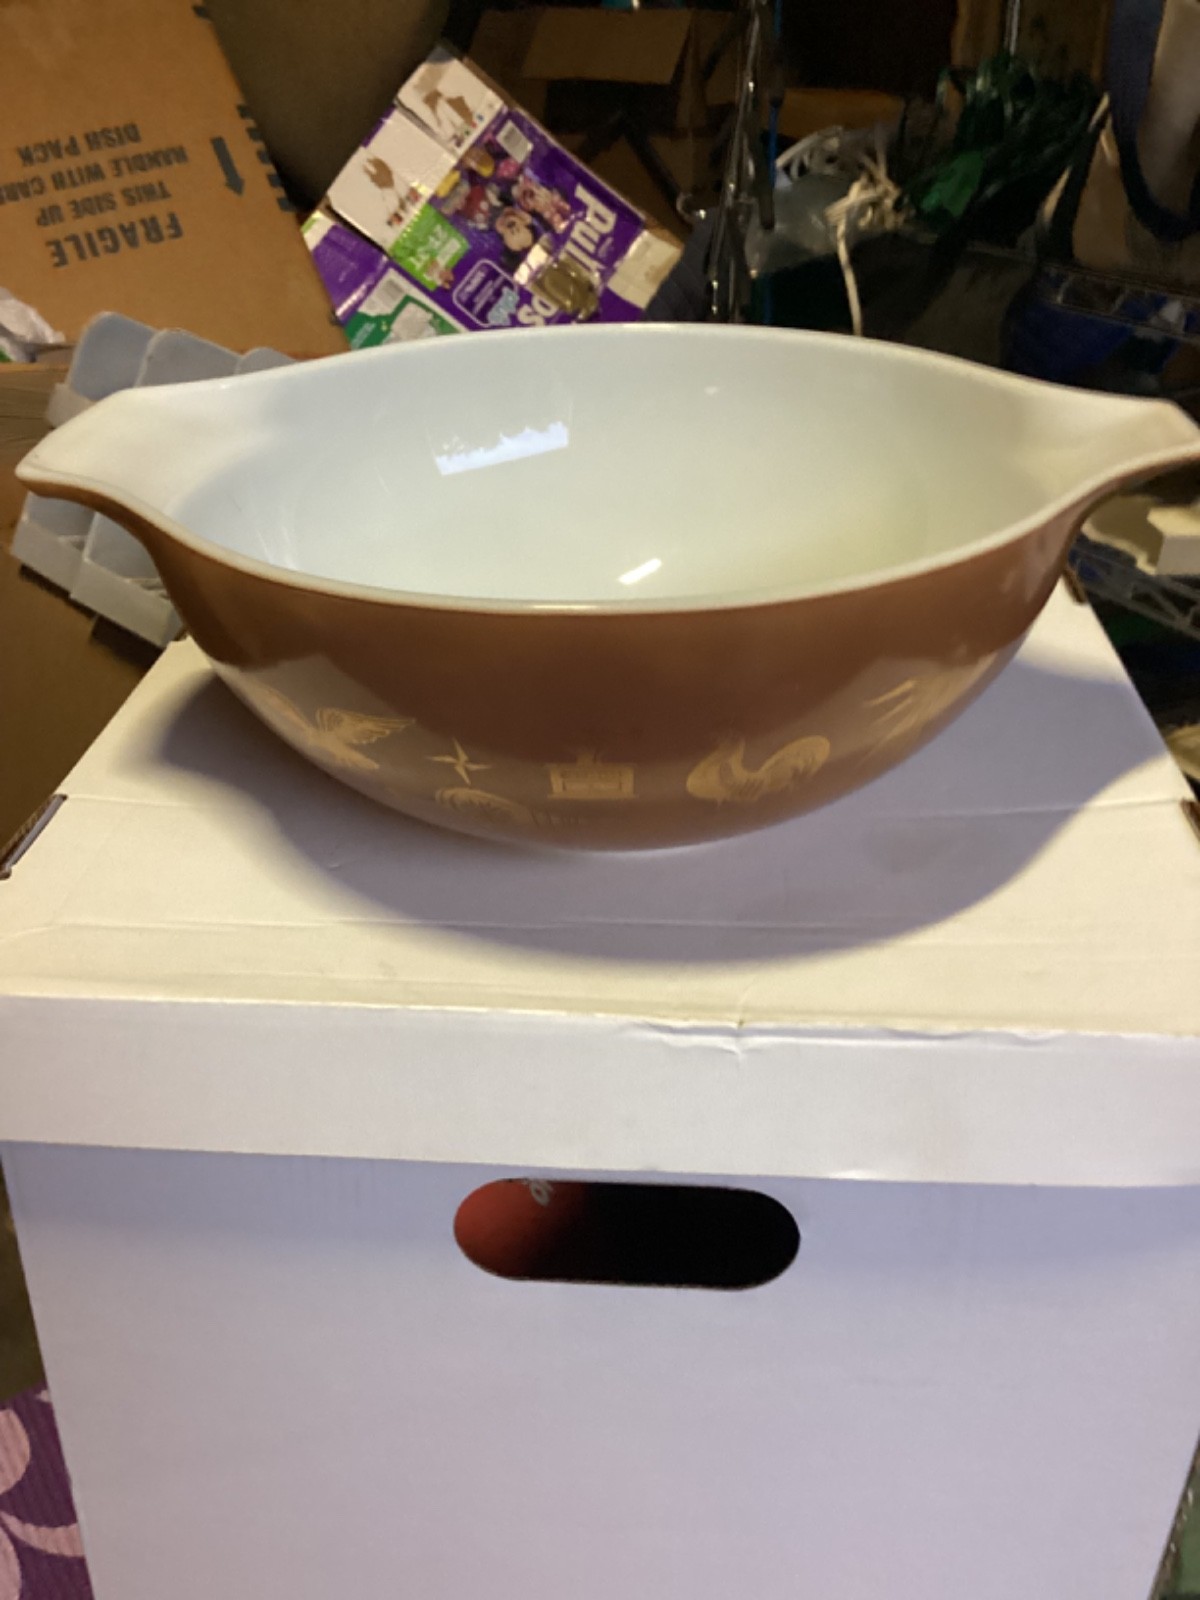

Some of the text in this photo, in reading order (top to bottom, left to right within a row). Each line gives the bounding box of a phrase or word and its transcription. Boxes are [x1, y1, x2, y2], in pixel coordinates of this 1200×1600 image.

[16, 122, 142, 167] DISH PACK
[110, 145, 189, 177] HANDLE
[52, 162, 107, 191] WITH
[36, 181, 172, 227] THIS SIDE UP
[45, 212, 184, 268] FRAGILE
